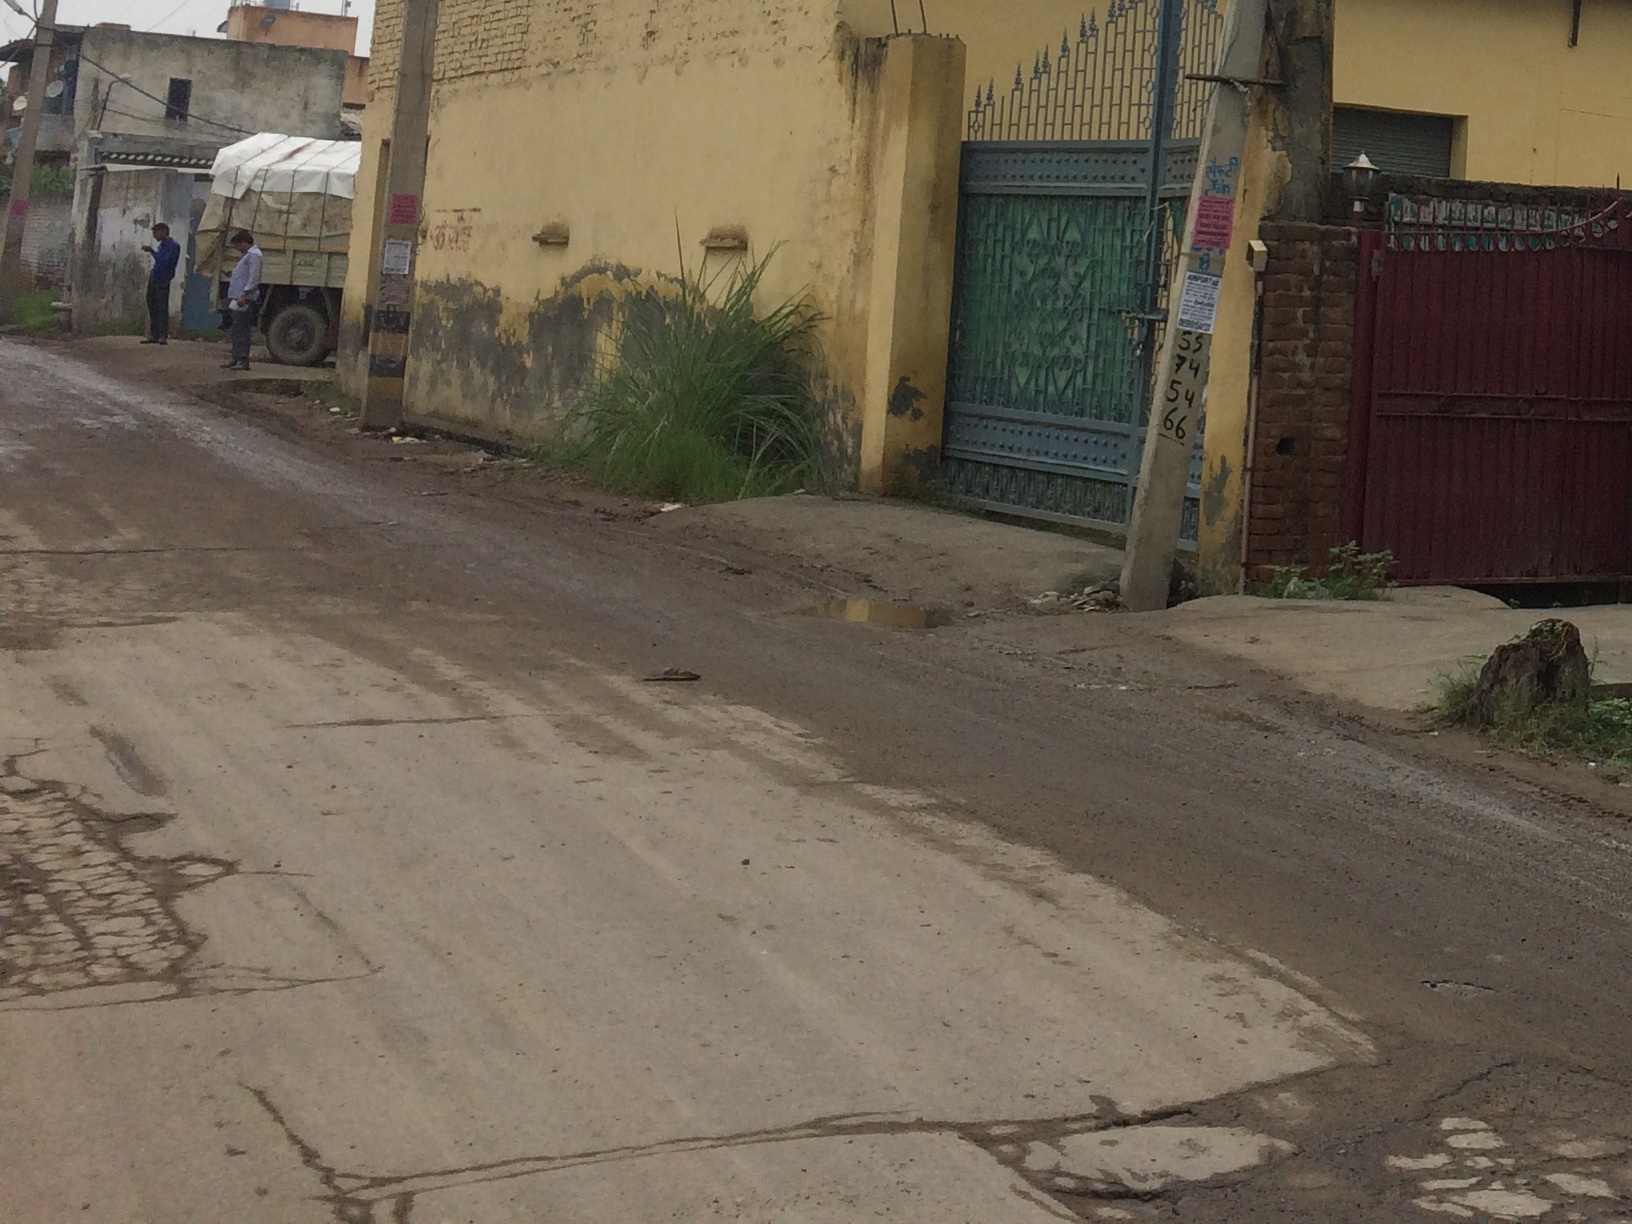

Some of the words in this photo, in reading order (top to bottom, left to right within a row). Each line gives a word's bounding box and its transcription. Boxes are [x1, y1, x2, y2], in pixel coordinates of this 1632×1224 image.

[1175, 354, 1200, 377] 74
[1166, 379, 1195, 408] 54
[1164, 407, 1187, 439] 66
